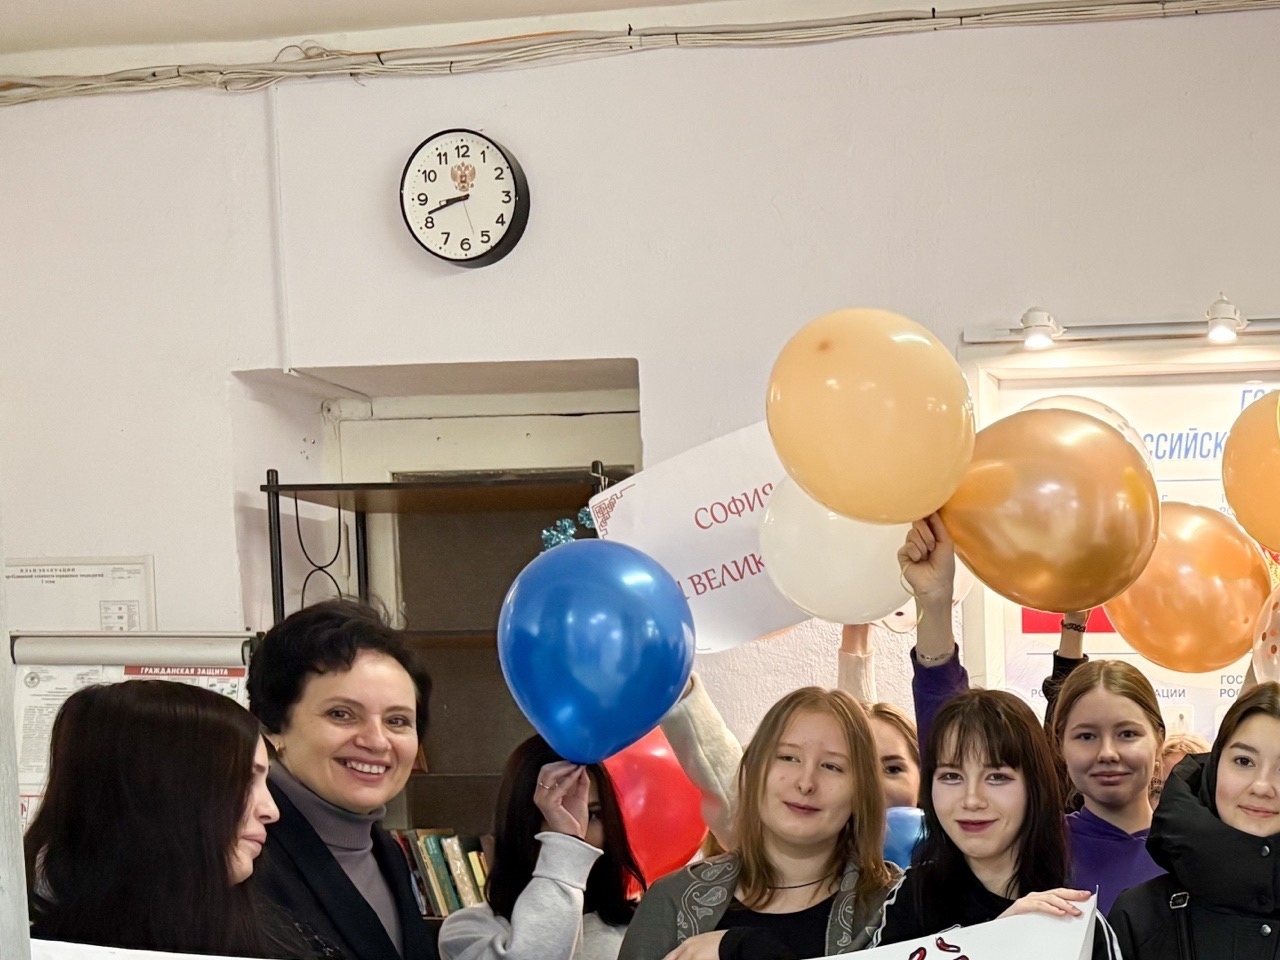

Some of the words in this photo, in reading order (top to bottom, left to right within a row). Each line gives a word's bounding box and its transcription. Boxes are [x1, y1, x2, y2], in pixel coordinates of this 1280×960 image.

[454, 145, 470, 158] 12
[480, 150, 486, 163] 1
[436, 152, 448, 165] 11
[421, 169, 437, 183] 10
[494, 167, 504, 180] 2
[417, 193, 428, 206] 9
[501, 190, 512, 204] 3
[424, 216, 435, 229] 8
[495, 213, 506, 226] 4
[441, 232, 450, 245] 7
[480, 231, 491, 243] 5
[460, 238, 471, 251] 6
[688, 553, 765, 596] ВЕЛИК
[140, 667, 195, 676] ГРАЖДАНСКАЯ
[196, 668, 229, 676] ЗАЩИТА
